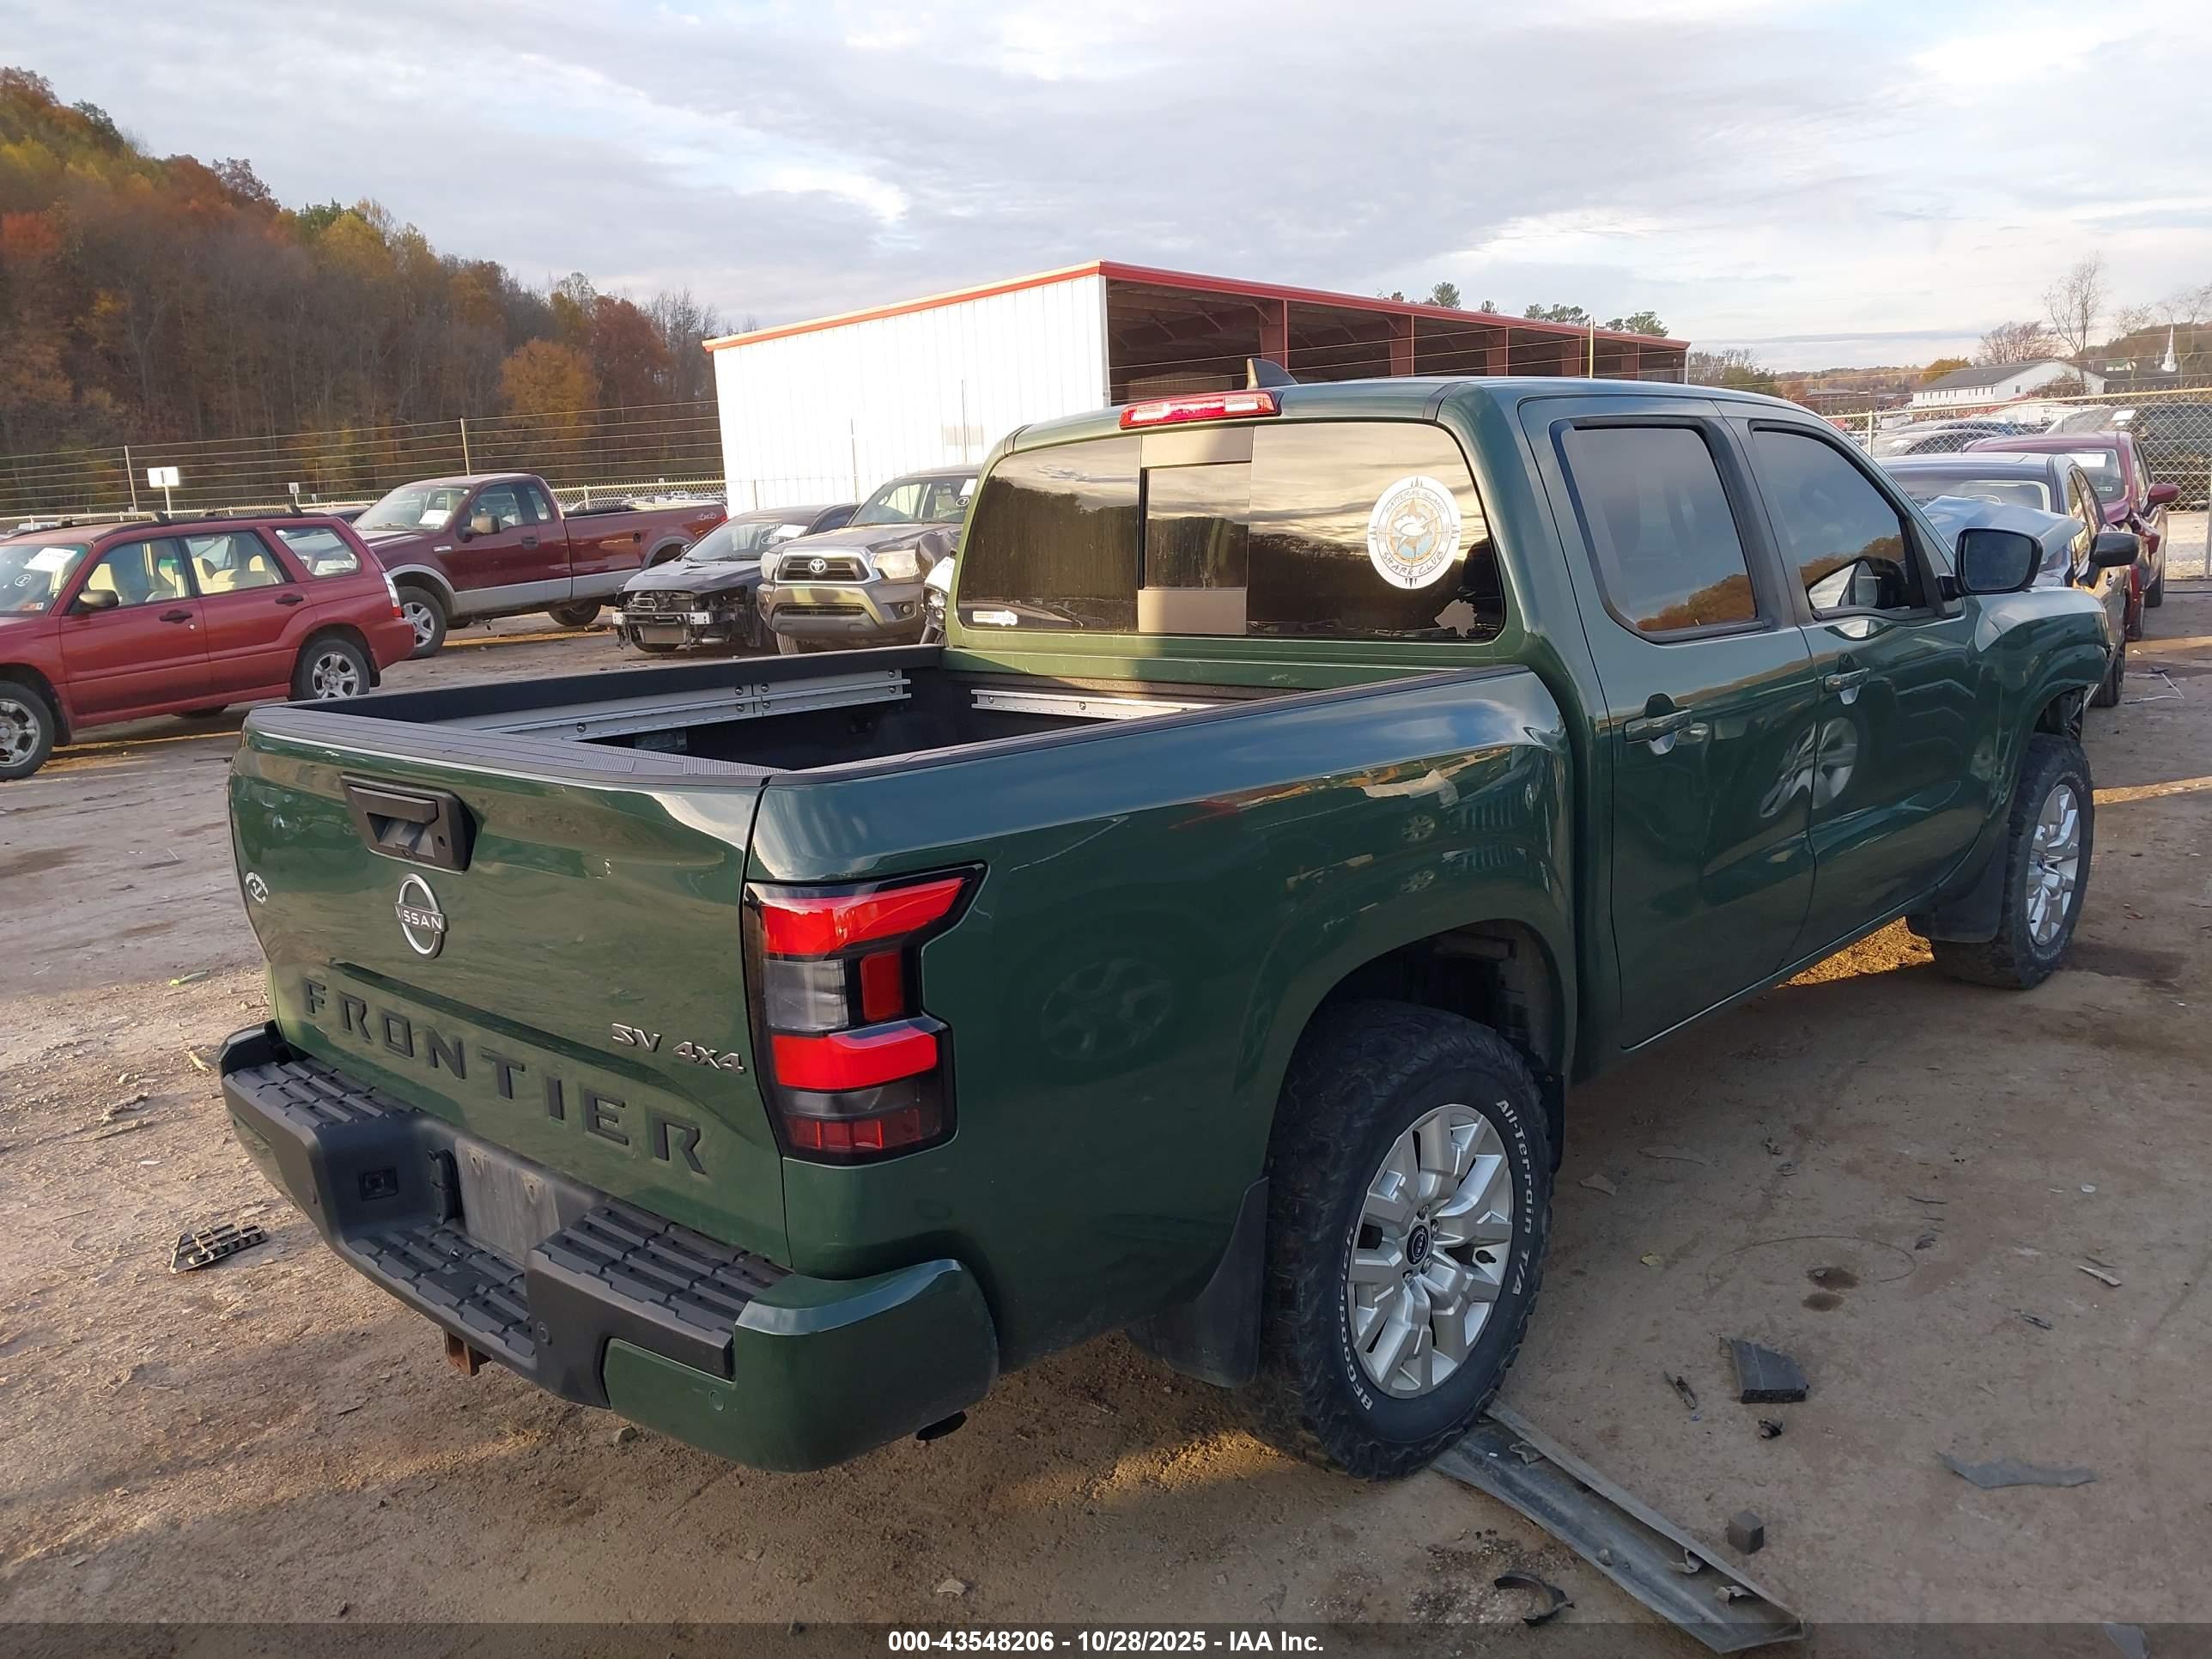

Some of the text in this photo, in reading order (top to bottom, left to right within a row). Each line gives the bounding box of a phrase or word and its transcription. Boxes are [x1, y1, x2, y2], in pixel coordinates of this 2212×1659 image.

[1382, 550, 1444, 576] SHARK CLUB
[395, 905, 442, 930] NISSAN
[302, 976, 708, 1176] FRONTIER
[611, 1023, 662, 1053] SV
[1496, 1100, 1534, 1297] All-Terrain T/A
[1339, 1226, 1374, 1411] BFGoodrich
